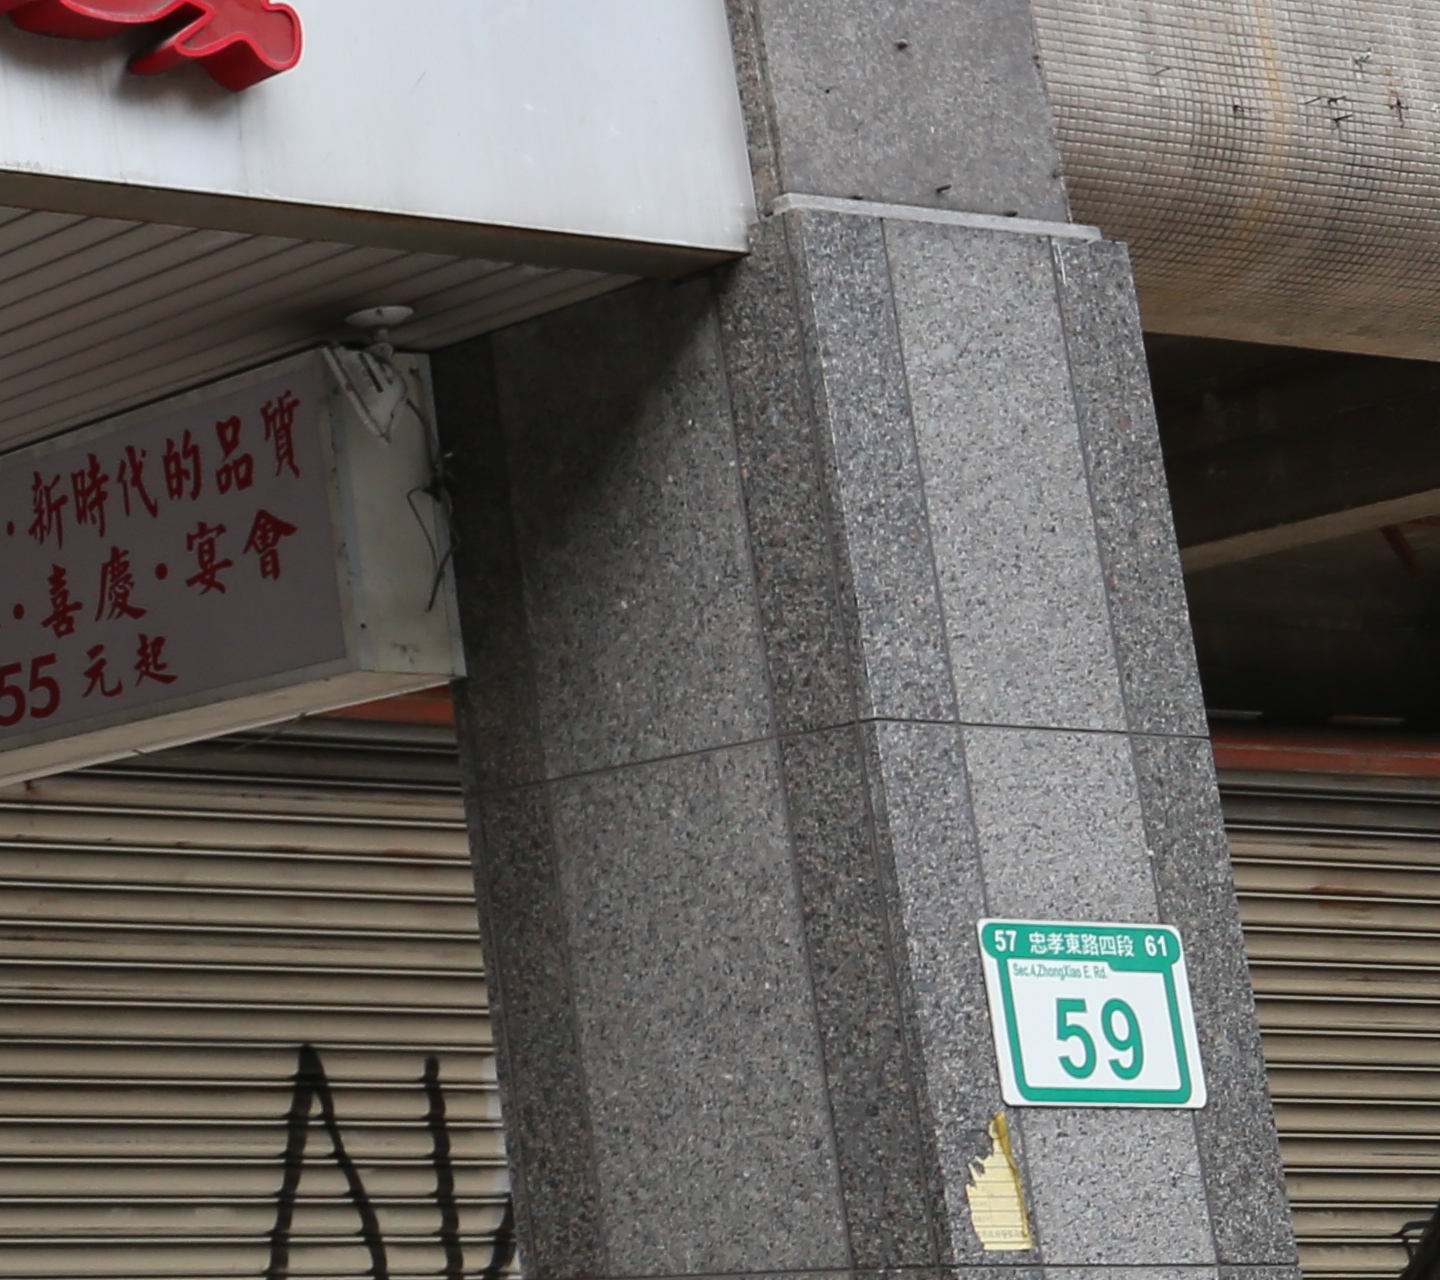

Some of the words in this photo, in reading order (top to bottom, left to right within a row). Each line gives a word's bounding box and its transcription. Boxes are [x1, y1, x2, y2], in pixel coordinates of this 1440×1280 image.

[994, 930, 1017, 952] 57
[1029, 931, 1135, 957] 忠孝東路四段
[1144, 934, 1168, 957] 61
[1056, 998, 1144, 1080] 59
